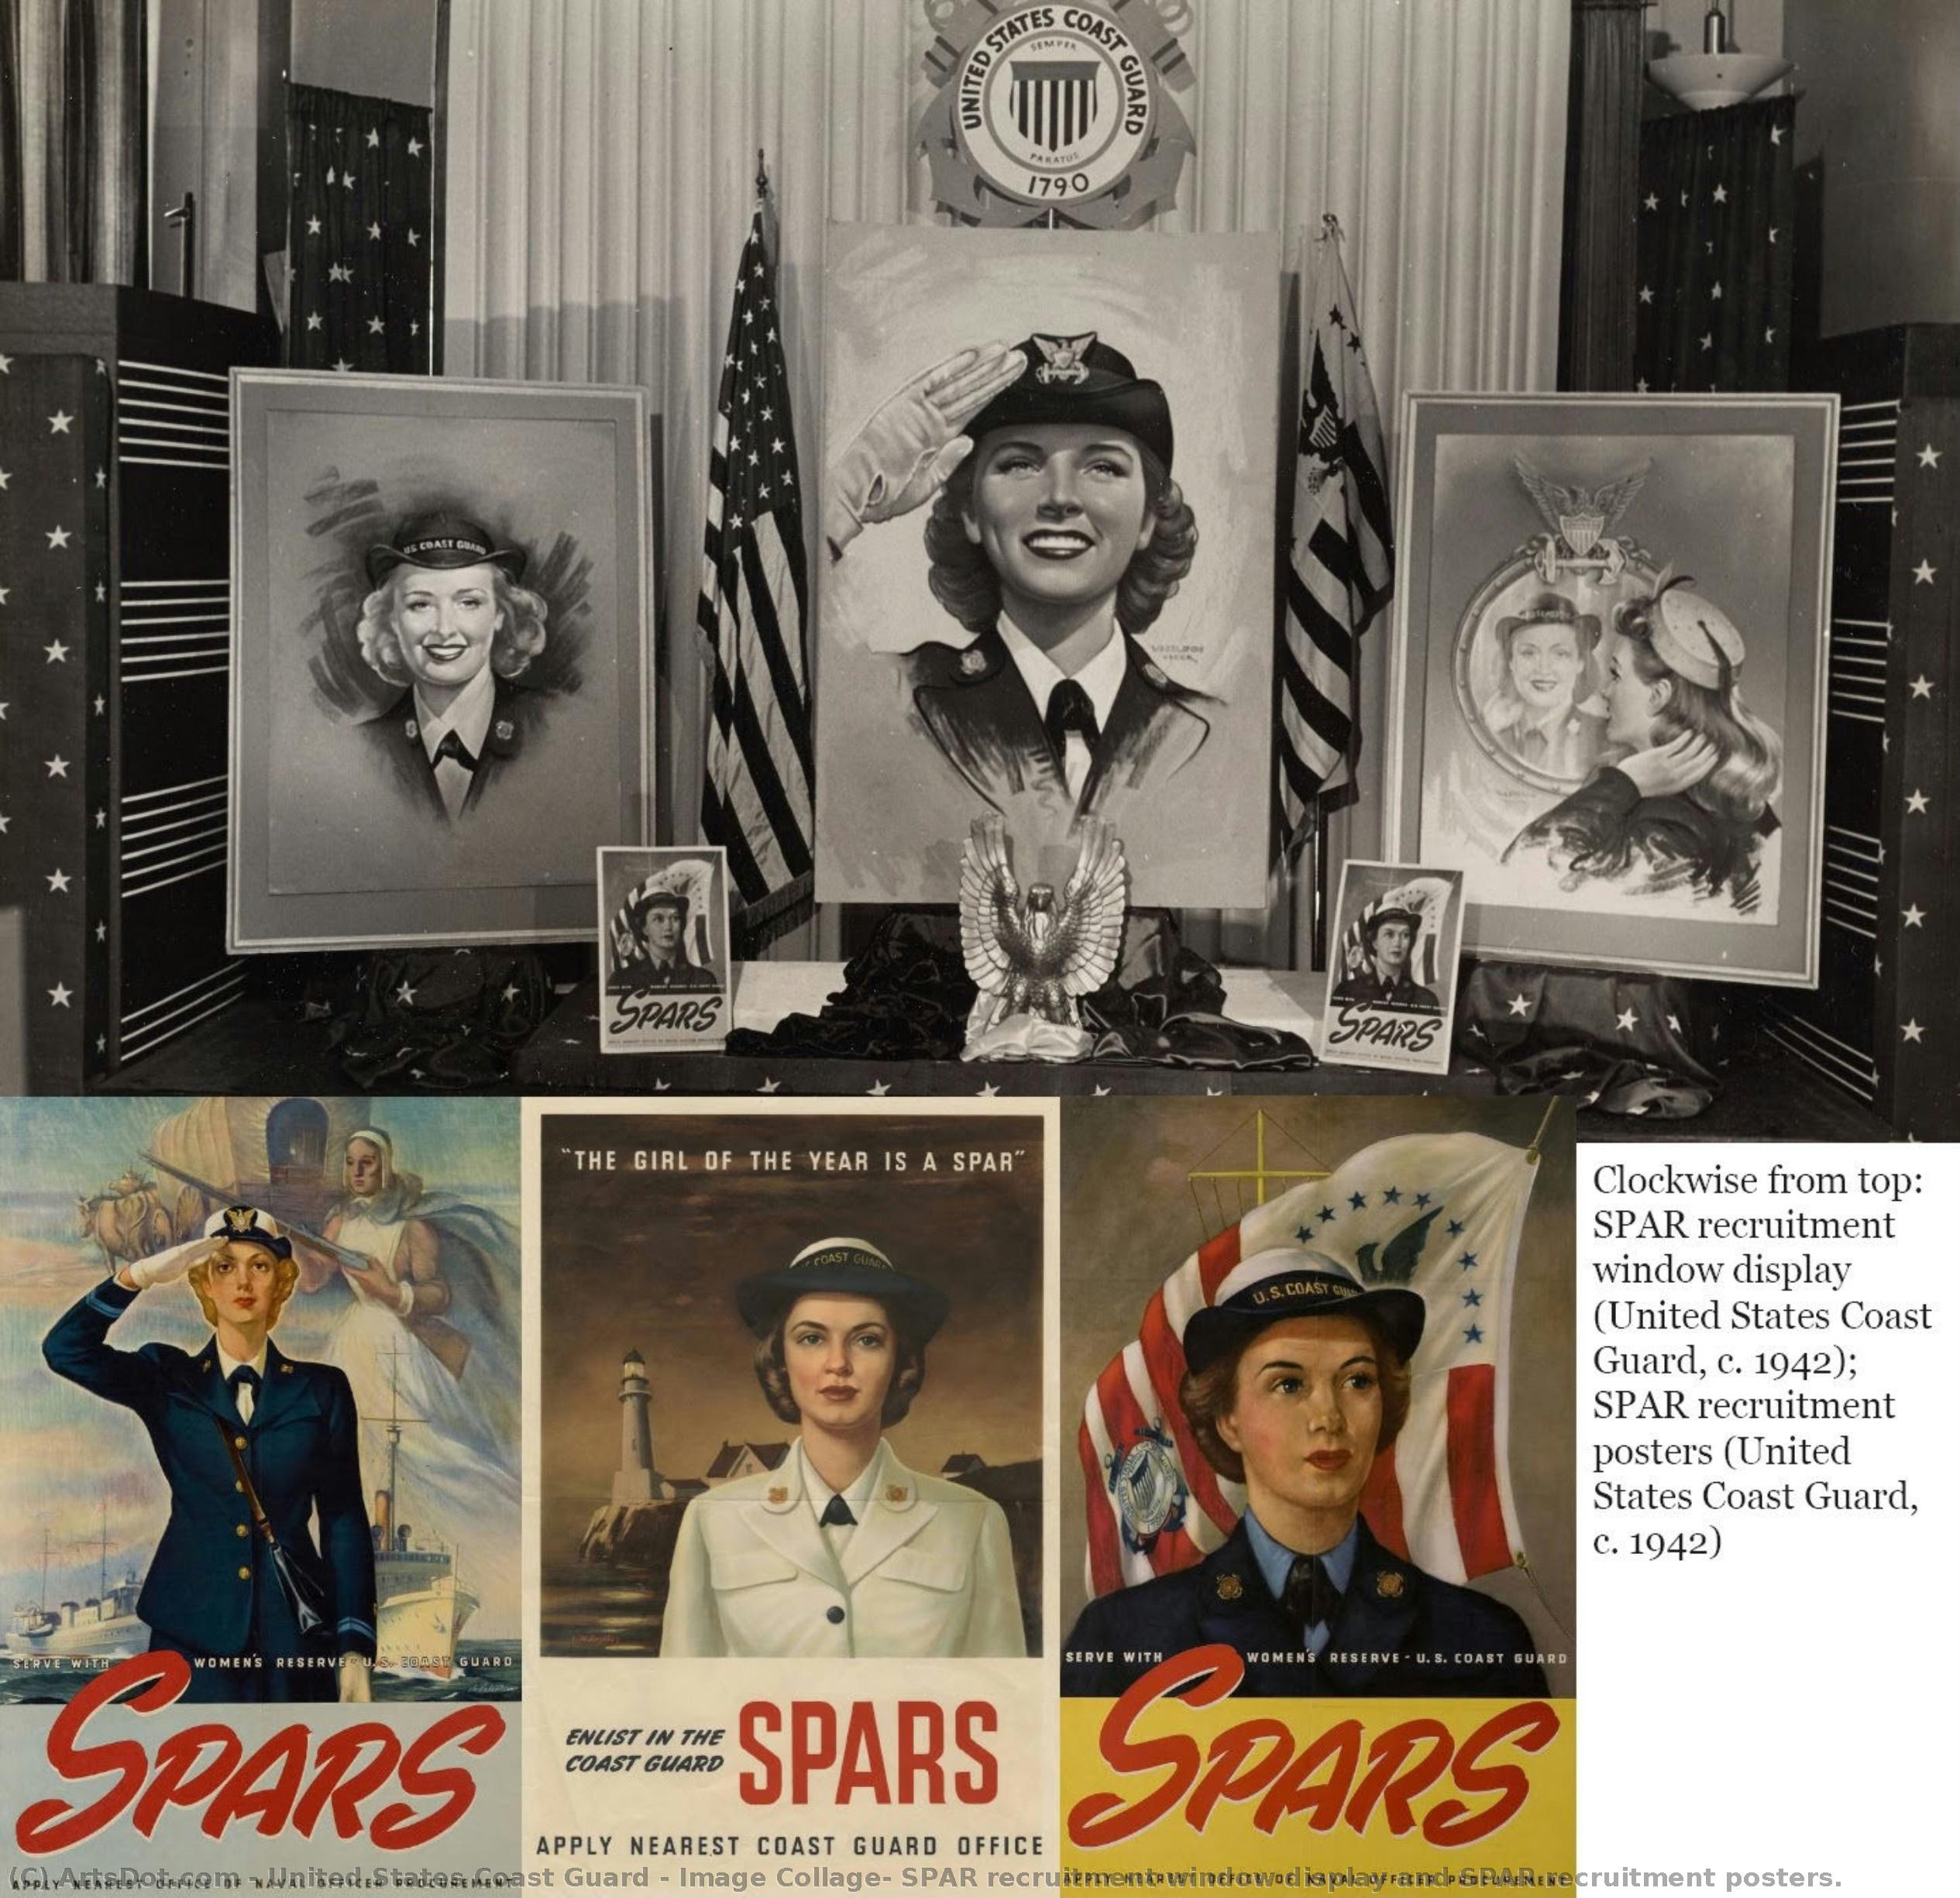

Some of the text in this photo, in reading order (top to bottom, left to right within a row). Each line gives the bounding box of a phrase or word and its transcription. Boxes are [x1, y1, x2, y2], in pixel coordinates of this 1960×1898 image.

[1030, 40, 1077, 52] SEMPER
[961, 8, 1147, 136] UNITED STATES COAST GUARD
[1030, 152, 1080, 164] PARATUS
[1027, 173, 1089, 197] 1790
[419, 539, 453, 550] COAST
[456, 540, 487, 555] GUARD
[609, 986, 724, 1035] SPARS
[1329, 1000, 1443, 1052] SPARS
[634, 1150, 689, 1171] GIRL
[705, 1150, 732, 1171] OF
[750, 1150, 792, 1171] THE
[809, 1150, 868, 1171] YEAR
[885, 1151, 906, 1171] IS
[923, 1151, 937, 1171] A
[1252, 1286, 1284, 1305] U.S.
[1285, 1282, 1329, 1296] COAST
[12, 1658, 61, 1669] SERVE
[71, 1658, 110, 1669] WITH
[194, 1653, 263, 1669] WOMEN'S
[277, 1656, 346, 1667] RESERVE
[401, 1656, 452, 1667] COAST
[459, 1656, 513, 1667] GUARD
[1065, 1652, 1114, 1662] SERVE
[1123, 1652, 1163, 1662] WITH
[1246, 1648, 1316, 1663] WOMEN'S
[1330, 1652, 1399, 1663] RESERVE
[1416, 1652, 1448, 1663] U.S.
[1454, 1652, 1504, 1663] COAST
[1514, 1652, 1567, 1663] GUARD
[566, 1728, 726, 1746] ENLIST IN THE
[1068, 1643, 1561, 1848] SPARS
[15, 1649, 507, 1855] SPARS
[739, 1700, 998, 1805] SPARS
[565, 1755, 725, 1772] COAST GUARD
[537, 1836, 1044, 1855] APPLY NEAREST COAST GUARD OFFICE
